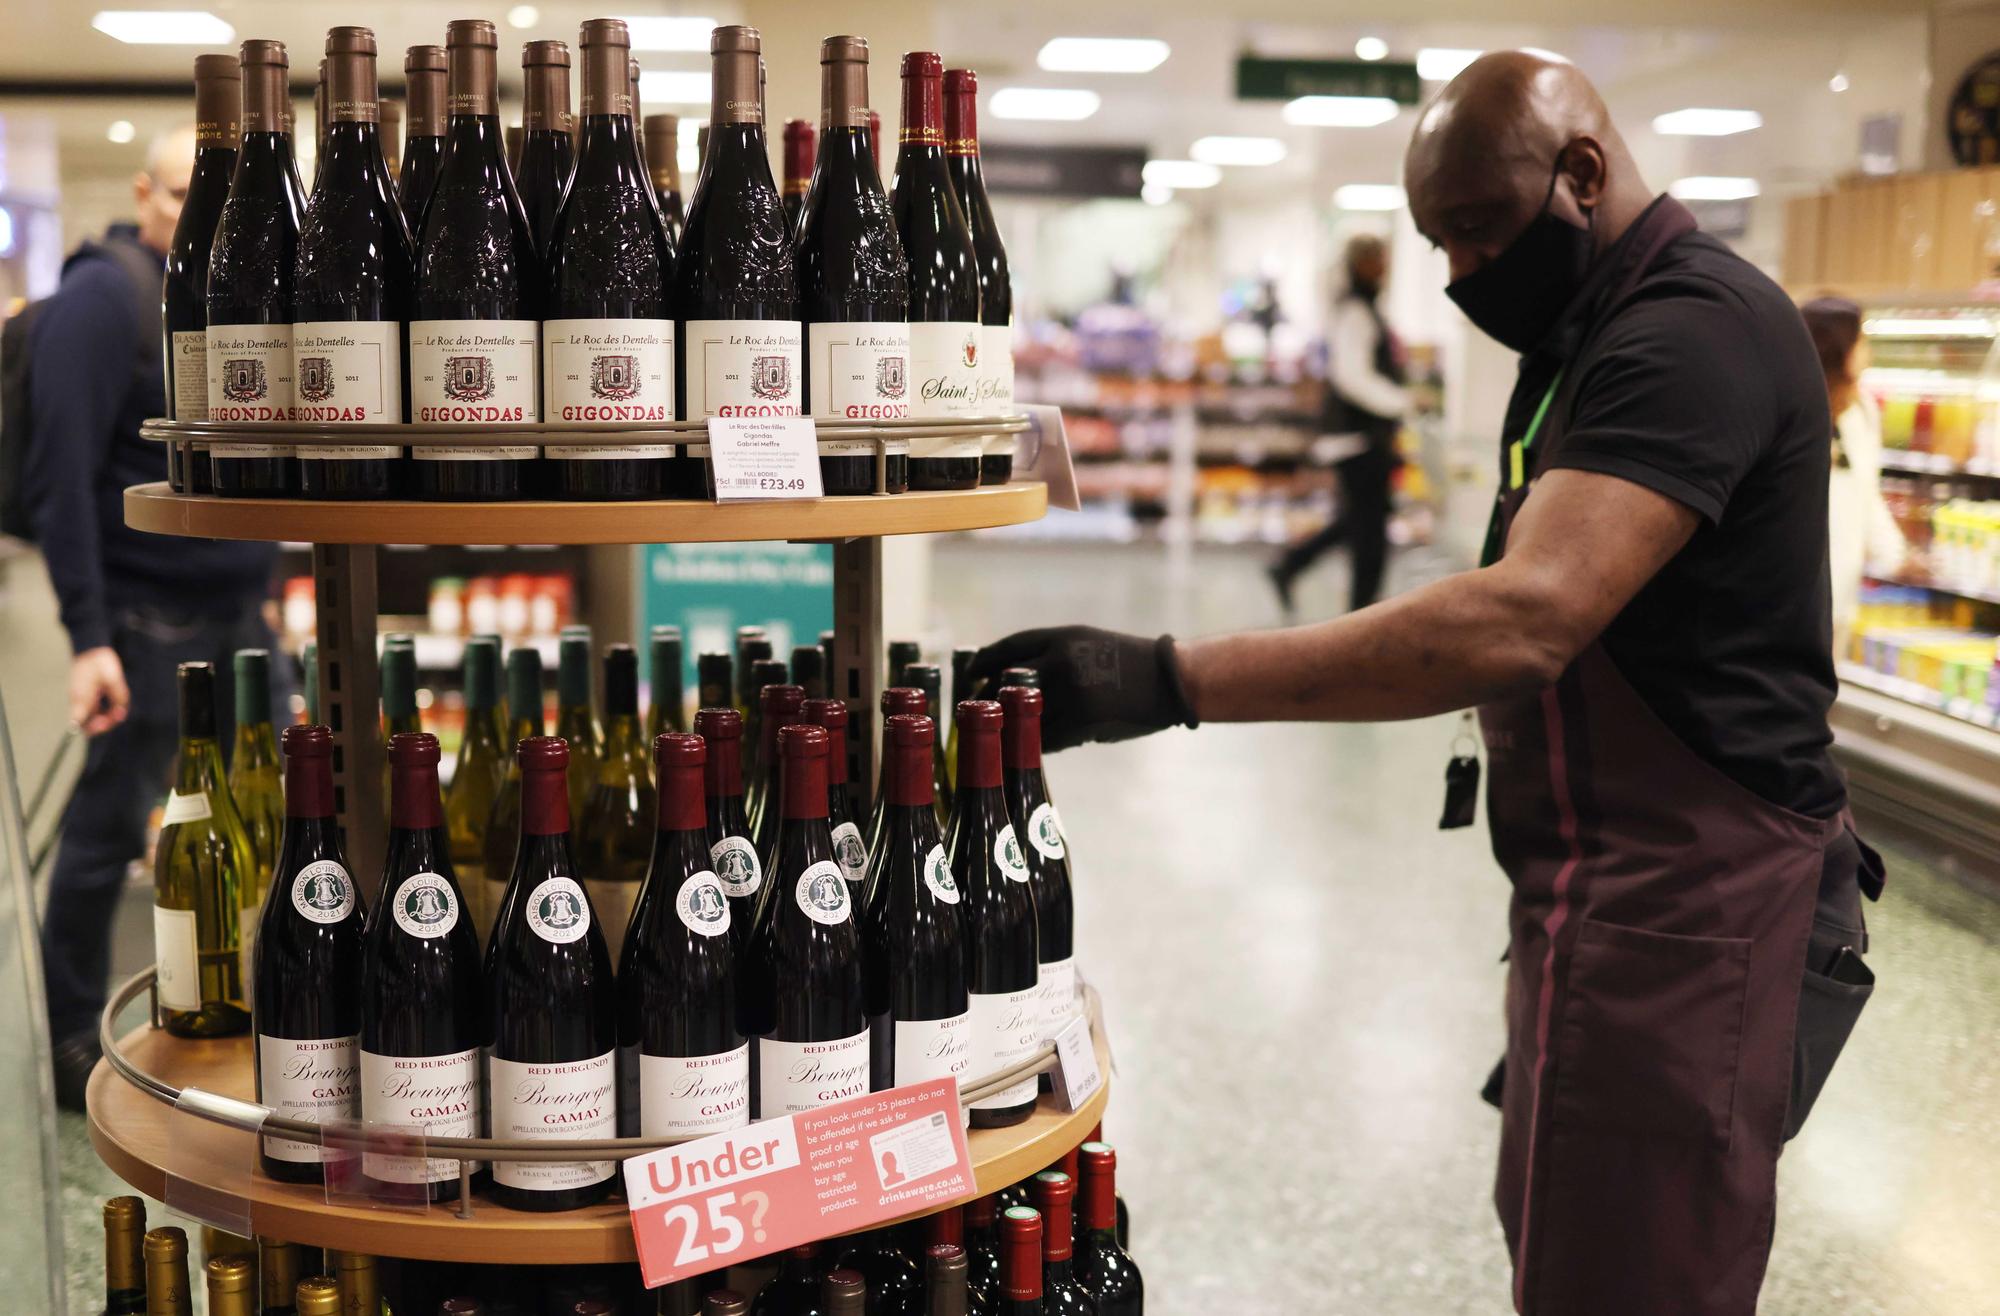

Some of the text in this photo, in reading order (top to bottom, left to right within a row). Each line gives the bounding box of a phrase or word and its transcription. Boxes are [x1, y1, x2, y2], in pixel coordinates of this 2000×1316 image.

[218, 341, 230, 349] Roc
[232, 340, 244, 349] des
[247, 339, 288, 349] Dentelles
[304, 337, 315, 347] des
[317, 336, 355, 346] Dentelles
[426, 335, 515, 346] Le Roc des Dentelles
[570, 334, 659, 345] Le Roc des Dentelles
[730, 336, 743, 345] Le
[745, 336, 762, 345] Roc
[764, 336, 777, 345] des
[856, 337, 897, 346] Le Roc des
[421, 407, 523, 422] GIGONDAS
[562, 406, 665, 421] GIGONDAS
[846, 405, 910, 418] GIGOND
[760, 479, 805, 490] £23.49
[296, 866, 351, 909] MAISON LOUIS LATOUR
[801, 875, 814, 911] MAISON
[399, 879, 453, 922] MAISON LOUIS LATOUR
[531, 892, 544, 928] MAISON
[545, 883, 570, 893] LOUIS
[682, 890, 696, 922] MAISON
[317, 910, 340, 918] 2021
[418, 924, 443, 932] 2021
[553, 929, 577, 937] 2021
[1010, 995, 1028, 1003] RED
[940, 1021, 958, 1029] RED
[296, 1043, 319, 1051] RED
[803, 1046, 826, 1054] RED
[394, 1061, 418, 1069] RED
[528, 1058, 608, 1075] RED BURGUNDY
[686, 1061, 709, 1069] RED
[819, 1081, 864, 1101] GAMAY
[410, 1100, 470, 1118] GAMAY
[701, 1094, 746, 1116] GAMAY
[804, 1088, 945, 1132] If you look under 25 please do not
[544, 1107, 601, 1124] GAMAY
[512, 1125, 548, 1133] APPELLATION
[549, 1124, 583, 1134] BOURGOGNE
[807, 1112, 908, 1145] be offended if we ask for
[810, 1139, 860, 1160] proof of age
[648, 1139, 780, 1194] Under
[812, 1157, 853, 1172] when you
[815, 1171, 846, 1186] buy age
[817, 1182, 857, 1200] restricted
[879, 1174, 964, 1206] drinkaware.co.uk
[936, 1189, 948, 1199] the
[949, 1185, 966, 1195] facts
[820, 1199, 859, 1216] products.
[664, 1191, 770, 1267] 25?
